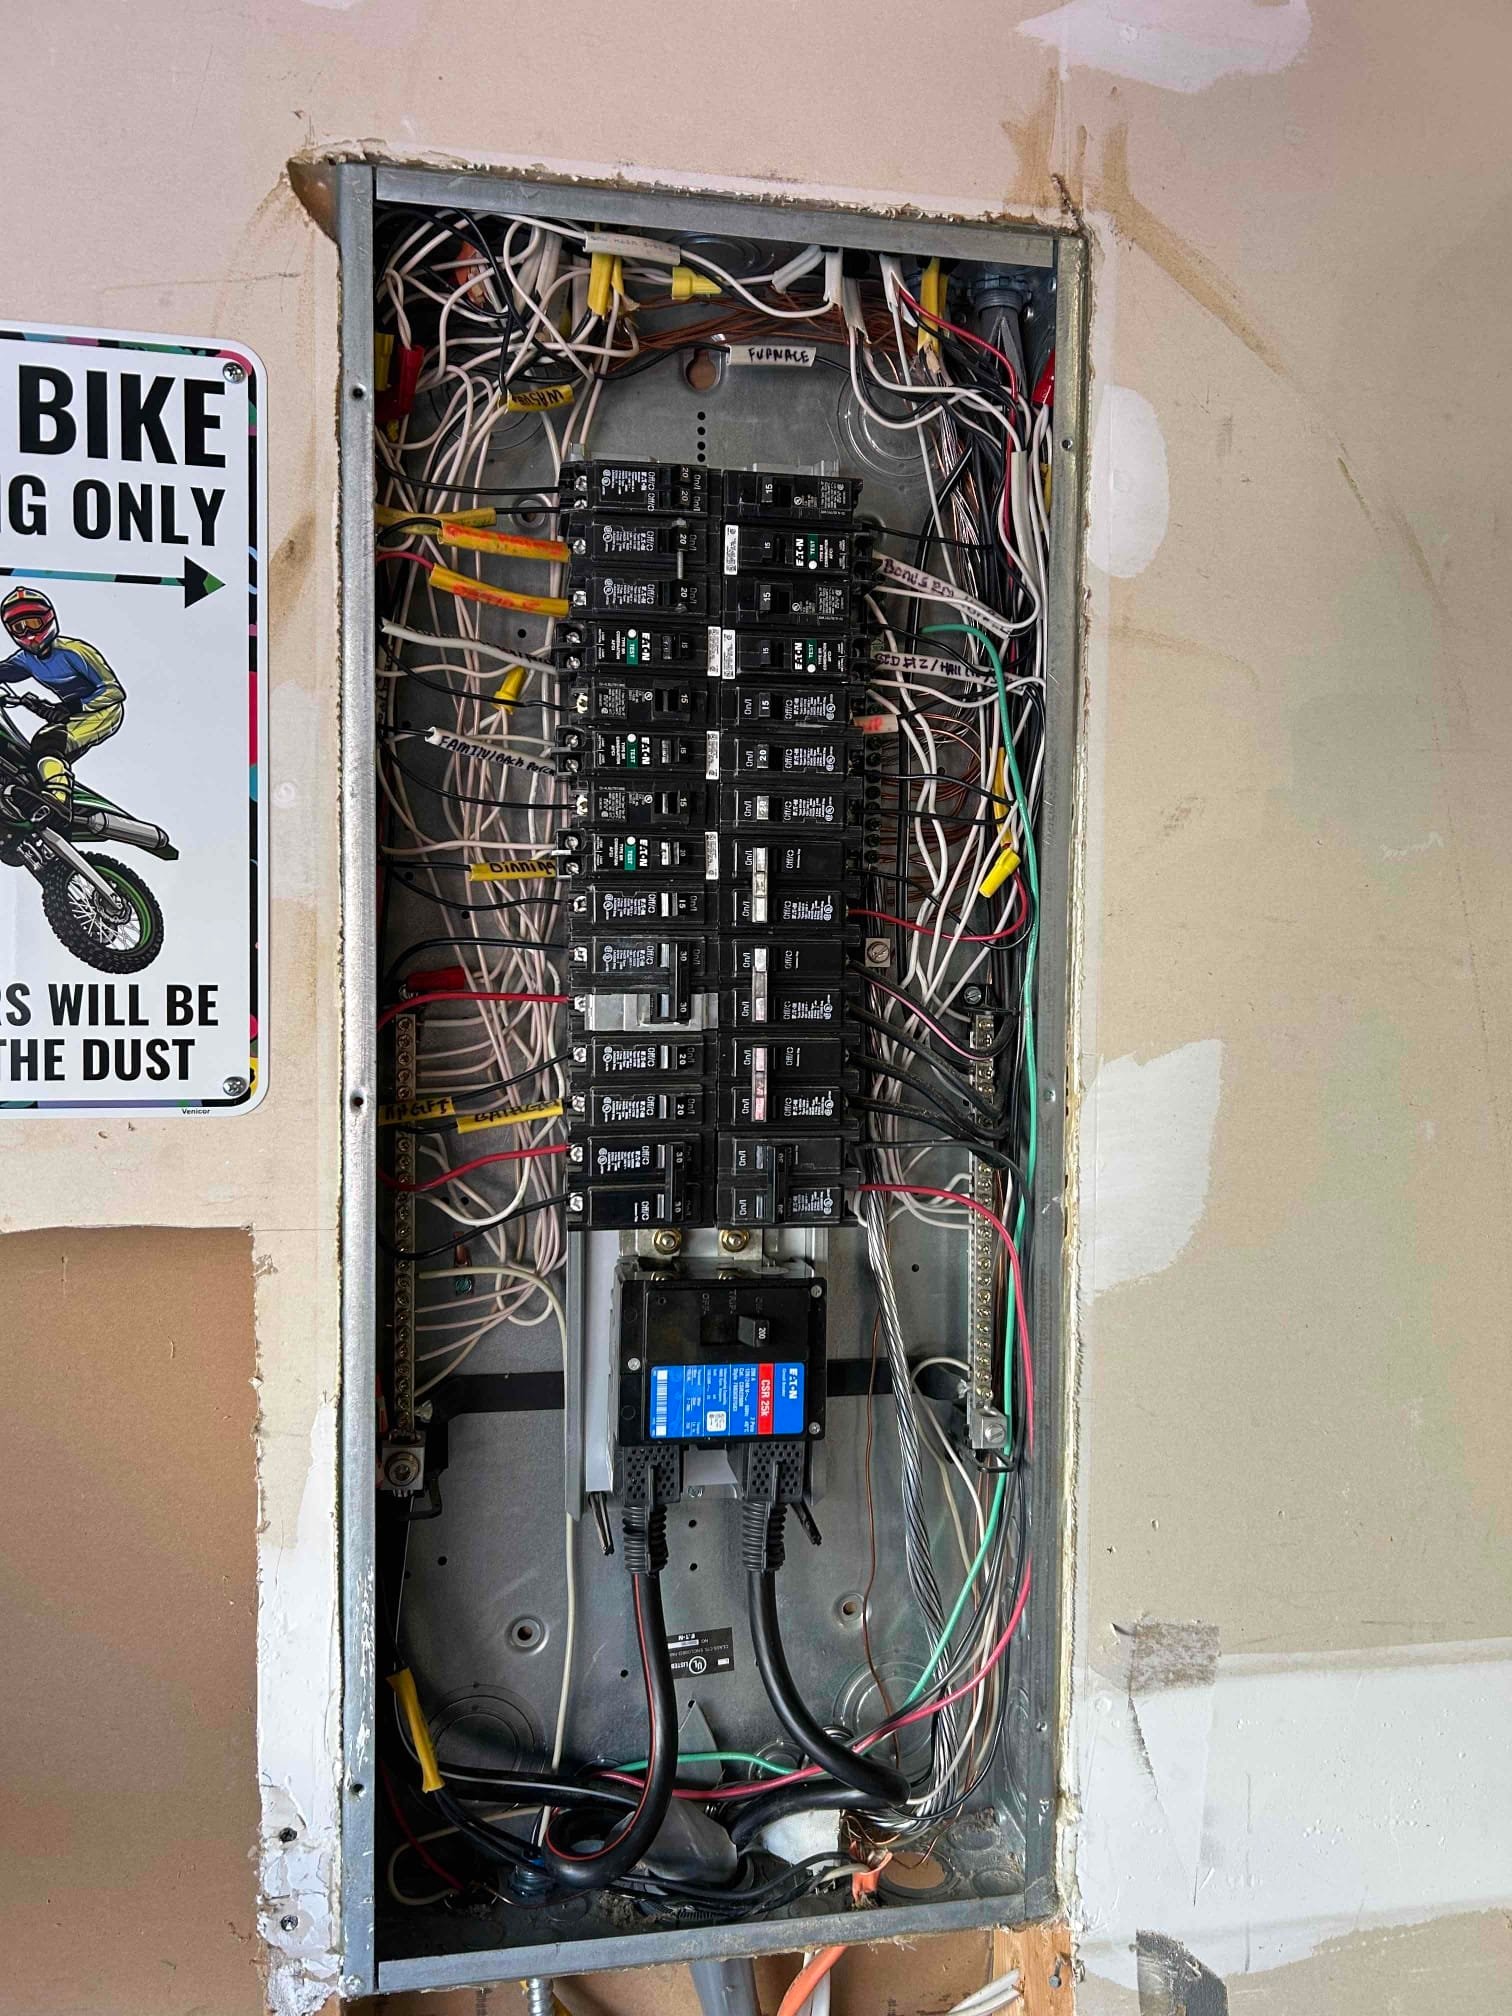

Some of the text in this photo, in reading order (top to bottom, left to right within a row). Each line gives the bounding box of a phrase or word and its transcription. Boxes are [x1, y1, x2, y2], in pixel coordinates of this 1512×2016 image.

[748, 347, 809, 363] FURNACE
[19, 364, 226, 468] BIKE
[682, 467, 689, 478] 20
[765, 483, 773, 494] 15
[682, 491, 689, 501] 20
[0, 474, 226, 546] G ONLY
[680, 534, 687, 544] 20
[681, 587, 687, 598] 20
[763, 592, 771, 602] 15
[681, 694, 688, 704] 15
[762, 700, 769, 710] 15
[759, 749, 767, 761] 20
[680, 797, 686, 807] 15
[679, 899, 686, 908] 15
[680, 951, 687, 961] 30
[0, 982, 219, 1026] S WILL BE
[680, 1002, 687, 1012] 30
[83, 1038, 195, 1081] DUST
[679, 1054, 686, 1065] 20
[678, 1104, 684, 1115] 20
[676, 1152, 683, 1163] 30
[761, 1380, 770, 1416] CSR 25k
